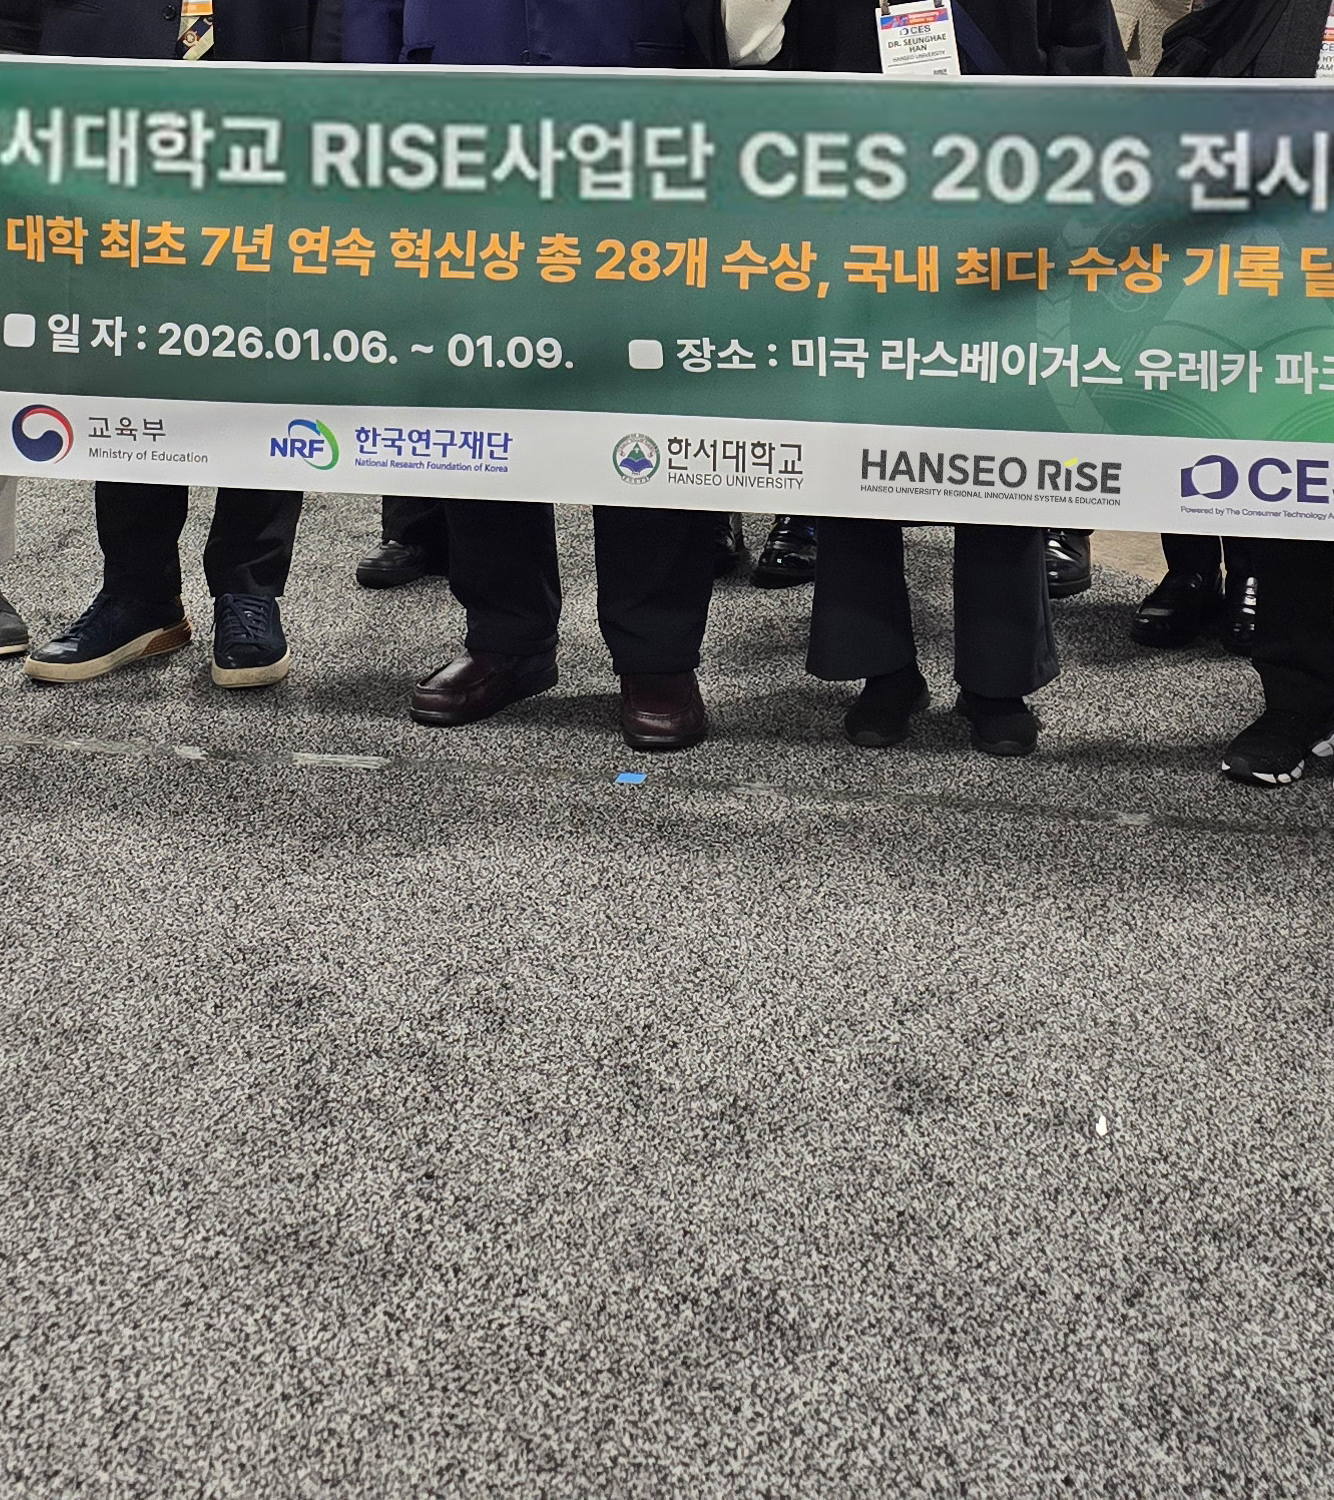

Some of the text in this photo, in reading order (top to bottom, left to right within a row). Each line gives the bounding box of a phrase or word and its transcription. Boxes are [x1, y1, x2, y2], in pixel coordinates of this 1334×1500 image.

[887, 32, 947, 49] DR. SEUNGHAE
[910, 24, 932, 35] CES
[908, 44, 927, 53] HAN
[310, 117, 716, 201] RISE사업단
[739, 131, 908, 201] CES
[931, 133, 1153, 207] 2026
[6, 213, 89, 266] 대학
[99, 218, 187, 269] 최초
[200, 223, 275, 273] 7년
[287, 225, 377, 277] 연속
[389, 227, 526, 282] 혁신상
[535, 233, 583, 284] 총
[594, 236, 709, 289] 28개
[721, 239, 831, 299] 수상,
[843, 244, 940, 293] 국내
[955, 246, 1056, 292] 최다
[1067, 243, 1171, 294] 수상
[1182, 243, 1285, 297] 기록
[158, 321, 398, 365] 2026.01.06.
[447, 333, 575, 370] 01.09.
[676, 336, 757, 373] 장소
[791, 335, 870, 379] 미국
[881, 336, 1124, 388] 라스베이거스
[1134, 348, 1263, 394] 유레카
[87, 415, 167, 442] 교육부
[270, 437, 325, 460] NRF
[354, 424, 514, 462] 한국연구재단
[88, 446, 209, 464] Ministry of Education
[354, 457, 509, 473] National Research Foundation of Korea
[667, 435, 804, 476] 한서대학교
[861, 448, 1028, 489] HANSEO
[668, 472, 804, 491] HANSEO UNIVERSITY
[860, 484, 1121, 506] HANSEO UNIVERSITY REGIONAL INNOVATION SYSTEM & EDUCATION
[1180, 505, 1214, 515] Powered
[1215, 507, 1225, 517] by
[1226, 508, 1241, 516] The
[1242, 508, 1282, 518] Consumer
[1283, 509, 1327, 520] Technology
